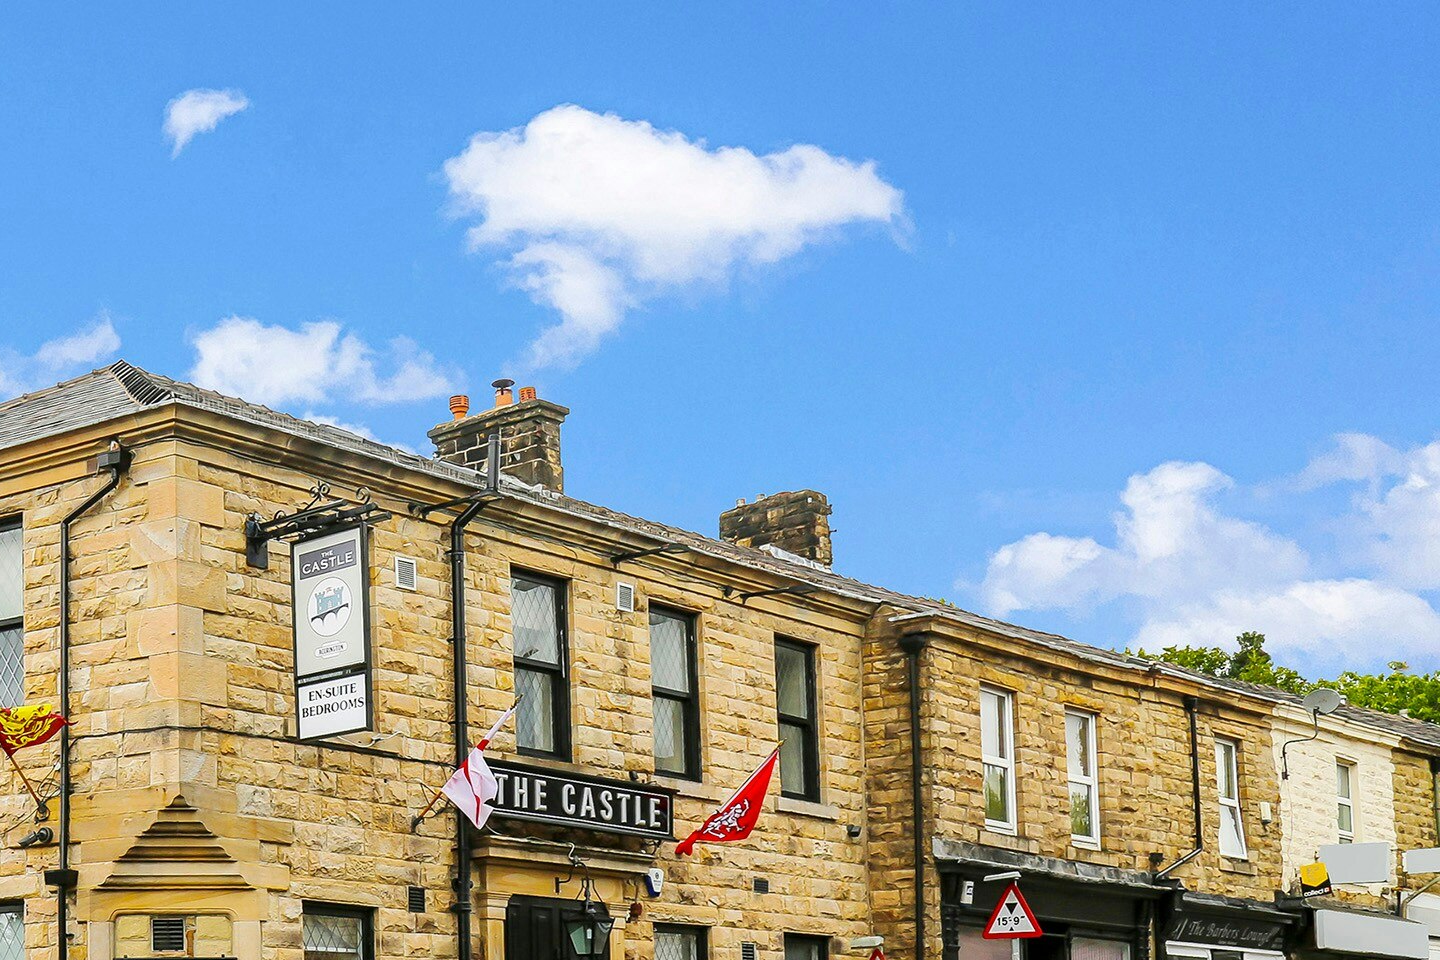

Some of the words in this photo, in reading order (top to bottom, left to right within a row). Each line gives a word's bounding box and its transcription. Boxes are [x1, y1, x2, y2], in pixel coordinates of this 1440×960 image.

[302, 551, 354, 575] CASTLE
[321, 550, 333, 558] THE
[308, 683, 357, 702] EN-SUITE
[302, 697, 364, 718] BEDROOMS
[494, 773, 548, 811] THE
[562, 783, 661, 828] CASTLE
[1188, 920, 1205, 936] The
[1206, 923, 1239, 939] Barbers
[1240, 927, 1273, 947] Lounge
